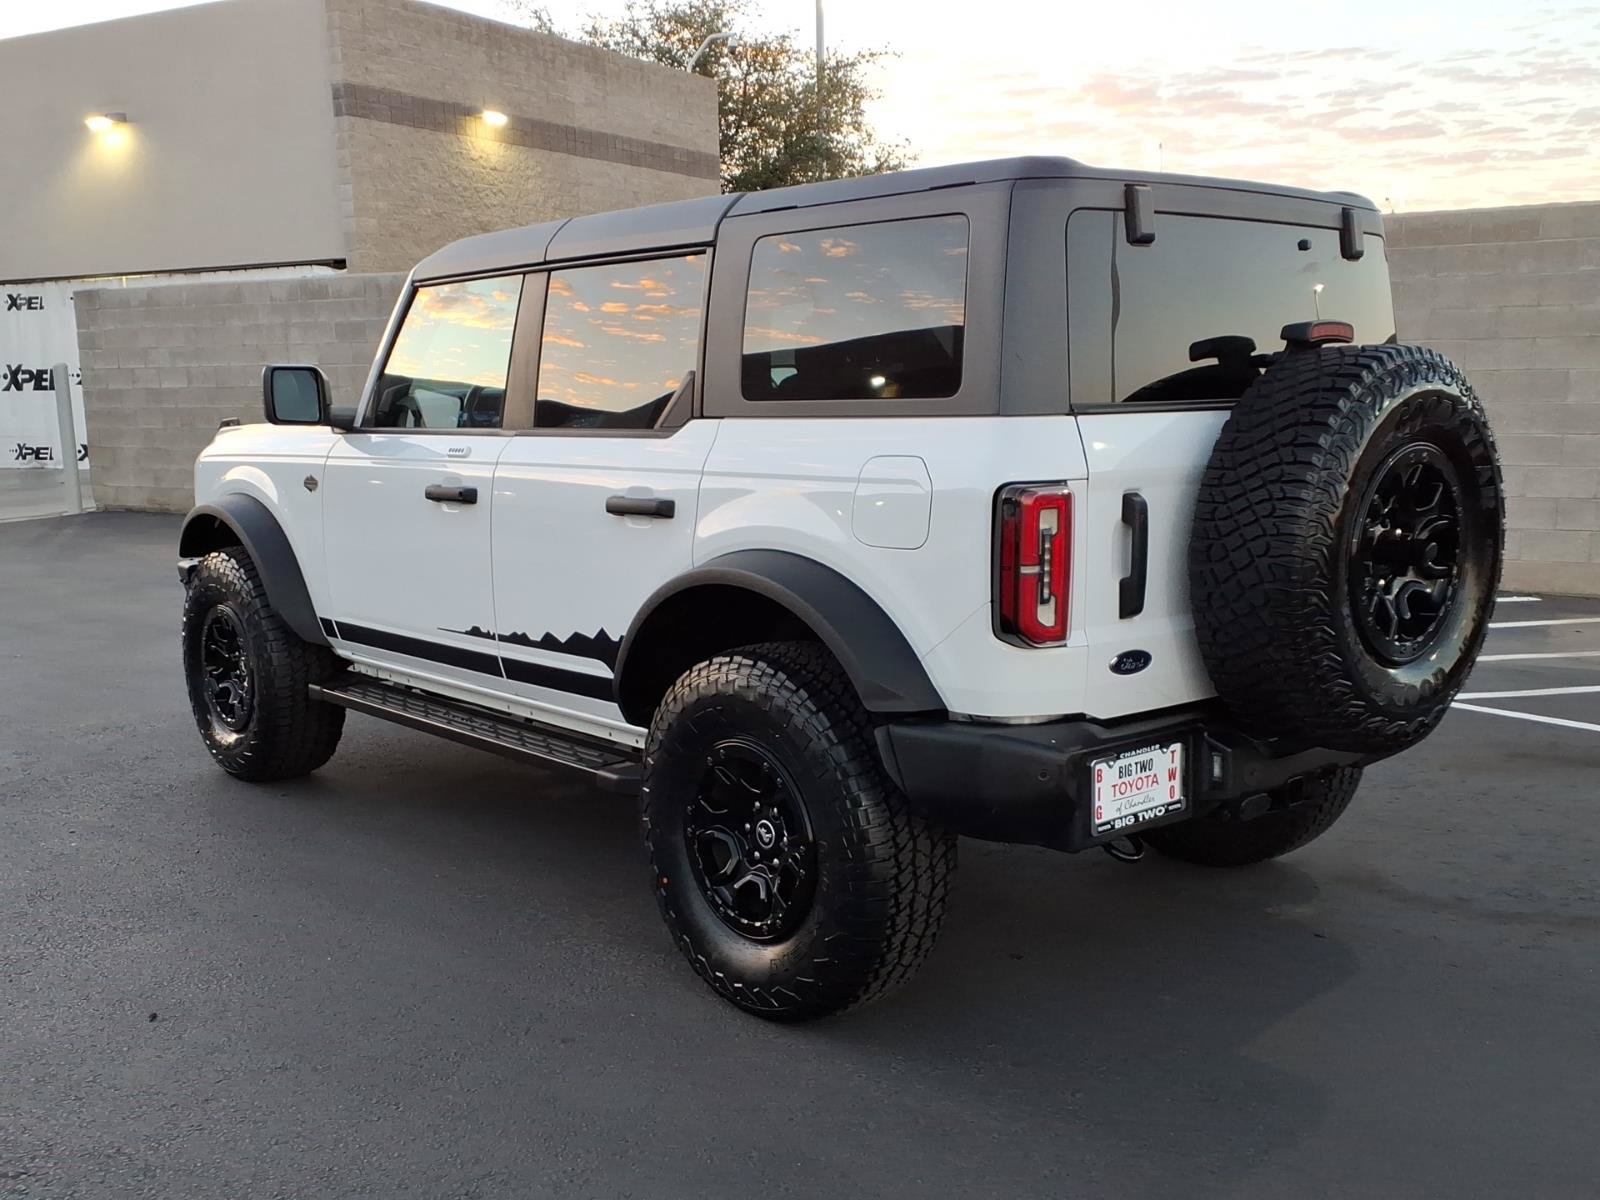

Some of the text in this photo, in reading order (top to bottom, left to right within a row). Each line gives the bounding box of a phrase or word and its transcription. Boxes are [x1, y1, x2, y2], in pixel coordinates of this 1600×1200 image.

[1120, 744, 1160, 759] CHANDLER
[1119, 758, 1153, 779] BIG TWO
[1112, 774, 1159, 797] TOYOTA
